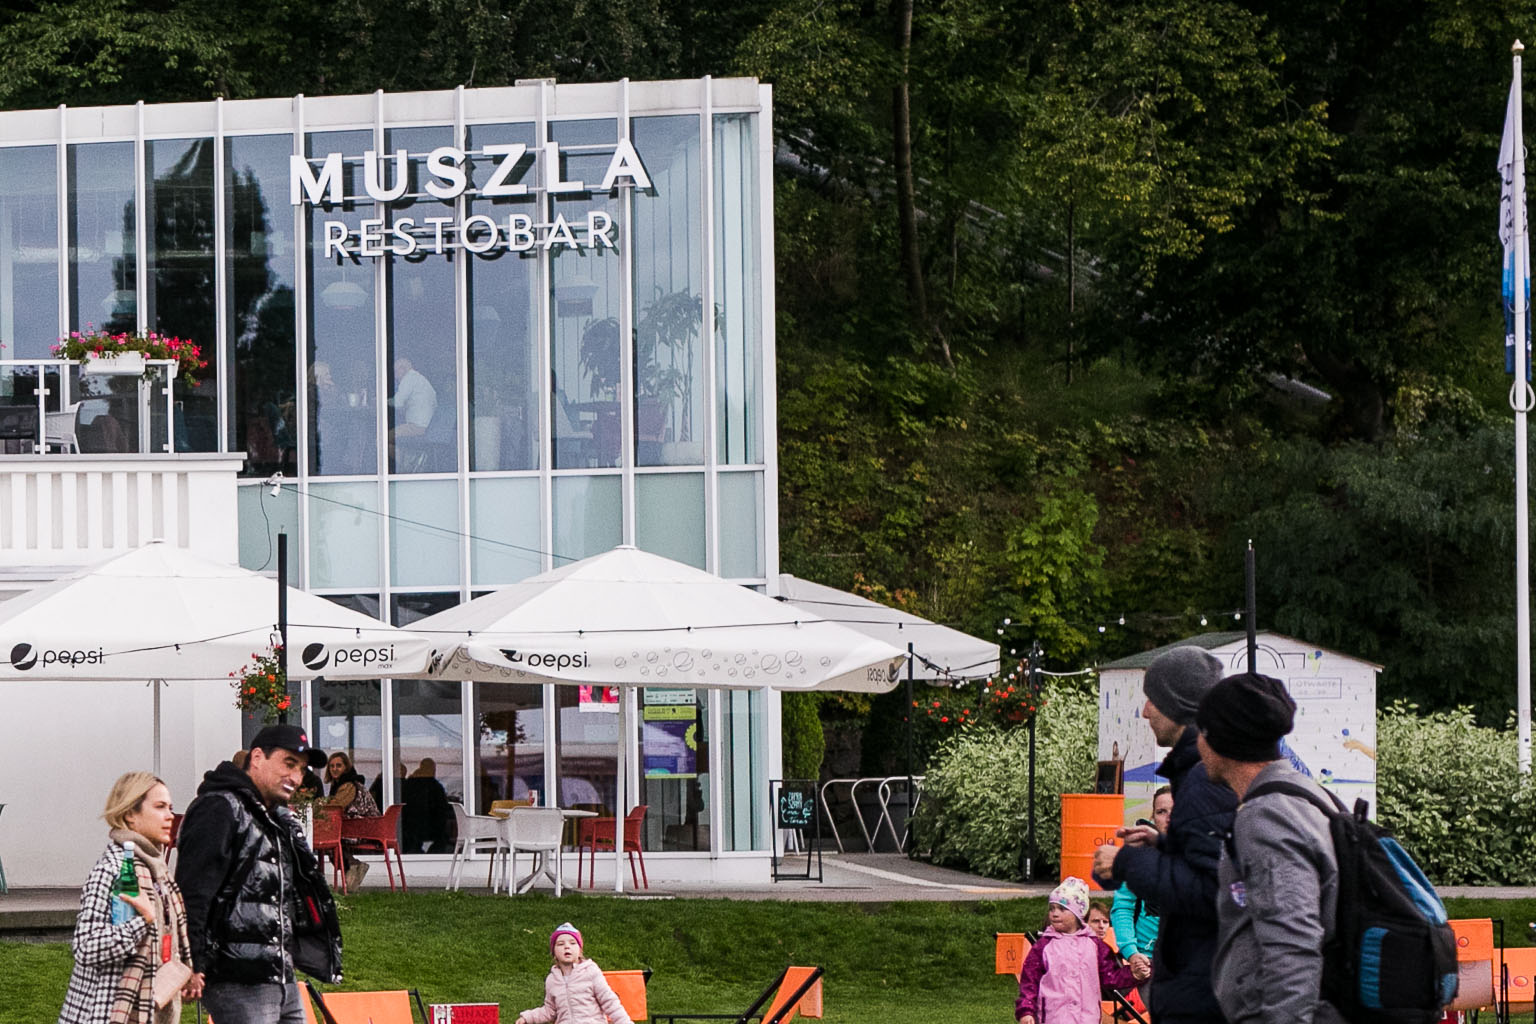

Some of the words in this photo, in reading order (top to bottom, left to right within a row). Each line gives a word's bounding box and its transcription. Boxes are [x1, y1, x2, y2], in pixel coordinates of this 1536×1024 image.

[290, 138, 651, 205] MUSZLA
[324, 211, 614, 258] RESTOBAR
[42, 647, 103, 668] pepsi
[334, 644, 395, 668] pepsi
[528, 652, 588, 671] pepsi
